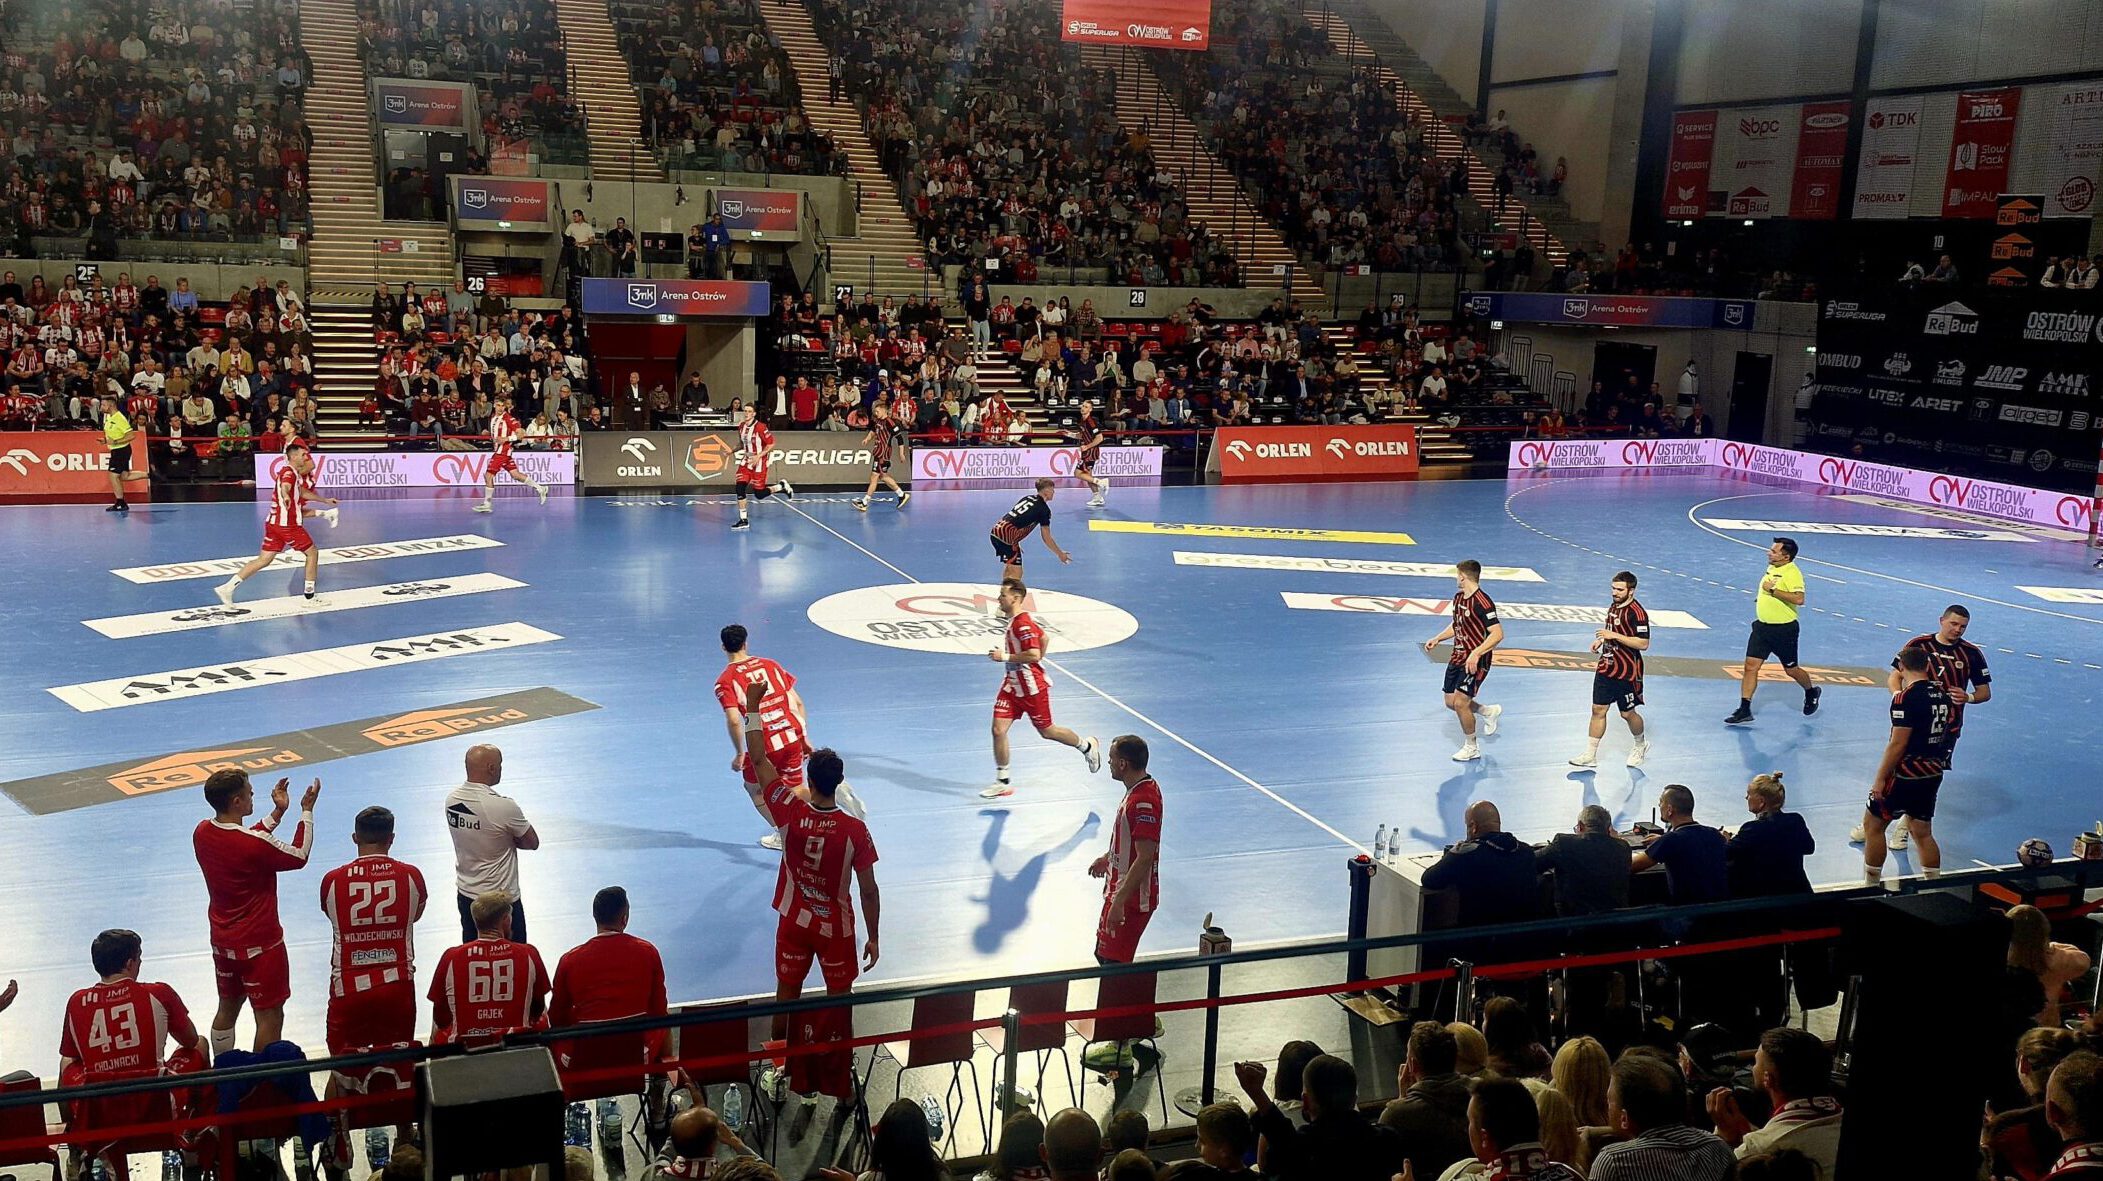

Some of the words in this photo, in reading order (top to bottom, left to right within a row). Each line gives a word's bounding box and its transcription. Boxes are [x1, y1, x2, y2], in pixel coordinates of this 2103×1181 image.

[408, 101, 430, 109] Arena
[431, 101, 457, 110] Ostrów
[1888, 112, 1917, 126] TDK
[1684, 124, 1712, 132] SERVICE
[1751, 117, 1780, 136] bpc
[1981, 145, 2006, 154] Slow
[1979, 156, 2004, 164] Pack
[490, 195, 512, 204] Arena
[513, 196, 540, 204] Ostrów
[745, 206, 766, 214] Arena
[766, 206, 792, 214] Ostrów
[1668, 204, 1698, 214] erima
[1934, 236, 1944, 248] 10
[77, 266, 96, 282] 25
[467, 277, 484, 291] 26
[661, 291, 689, 300] Arena
[692, 290, 727, 300] Ostrów
[1131, 292, 1144, 304] 28
[1591, 304, 1615, 314] Arena
[1617, 304, 1649, 314] Ostrów
[1835, 311, 1886, 321] SUPERLIGA
[1928, 317, 1979, 334] ReBud
[2027, 310, 2095, 333] OSTRÓW
[2023, 328, 2089, 344] WIELKOPOLSKI
[1976, 366, 2028, 382] JMP
[1868, 388, 1905, 402] LITEX
[1910, 396, 1964, 412] ARET
[1256, 443, 1311, 458] ORLEN
[1354, 442, 1408, 456] ORLEN
[1554, 442, 1598, 456] OSTRÓW
[1658, 440, 1700, 455] OSTRÓW
[47, 452, 133, 472] ORLE
[326, 454, 394, 474] OSTRÓW
[734, 450, 872, 465] SPERLIGA
[968, 450, 1021, 466] OSTRÓW
[1551, 456, 1606, 466] WIELKOPOLSKI
[1654, 455, 1707, 465] WIELKOPOLSKI
[1754, 450, 1797, 467] OSTRÓW
[616, 466, 662, 477] ORLEN
[964, 465, 1030, 477] WIELKOPOLSKI
[1751, 461, 1802, 478] WIELKOPOLSKI
[1855, 468, 1904, 485] OSTRÓW
[322, 473, 408, 485] WIELKOPOLSKI
[1852, 478, 1910, 498] WIELKOPOLSKI
[1971, 486, 2026, 506] OSTRÓW
[1014, 500, 1034, 514] 15
[1967, 499, 2034, 519] WIELKOPOLSKI
[1193, 525, 1329, 536] TASOMIX
[399, 537, 477, 552] MZK
[1938, 666, 1945, 676] 7
[382, 707, 529, 748] ReBud
[124, 748, 304, 789] ReBud
[818, 820, 837, 828] JMP
[804, 836, 824, 871] 9
[371, 863, 392, 871] JMP
[348, 880, 397, 926] 22
[344, 929, 404, 943] WOJCIECHOWSKI
[490, 944, 510, 952] JMP
[468, 958, 514, 1003] 68
[106, 986, 130, 998] JMP
[477, 1008, 504, 1020] GAJEK
[88, 1002, 140, 1054] 43
[94, 1054, 140, 1073] CHOJNACKI
